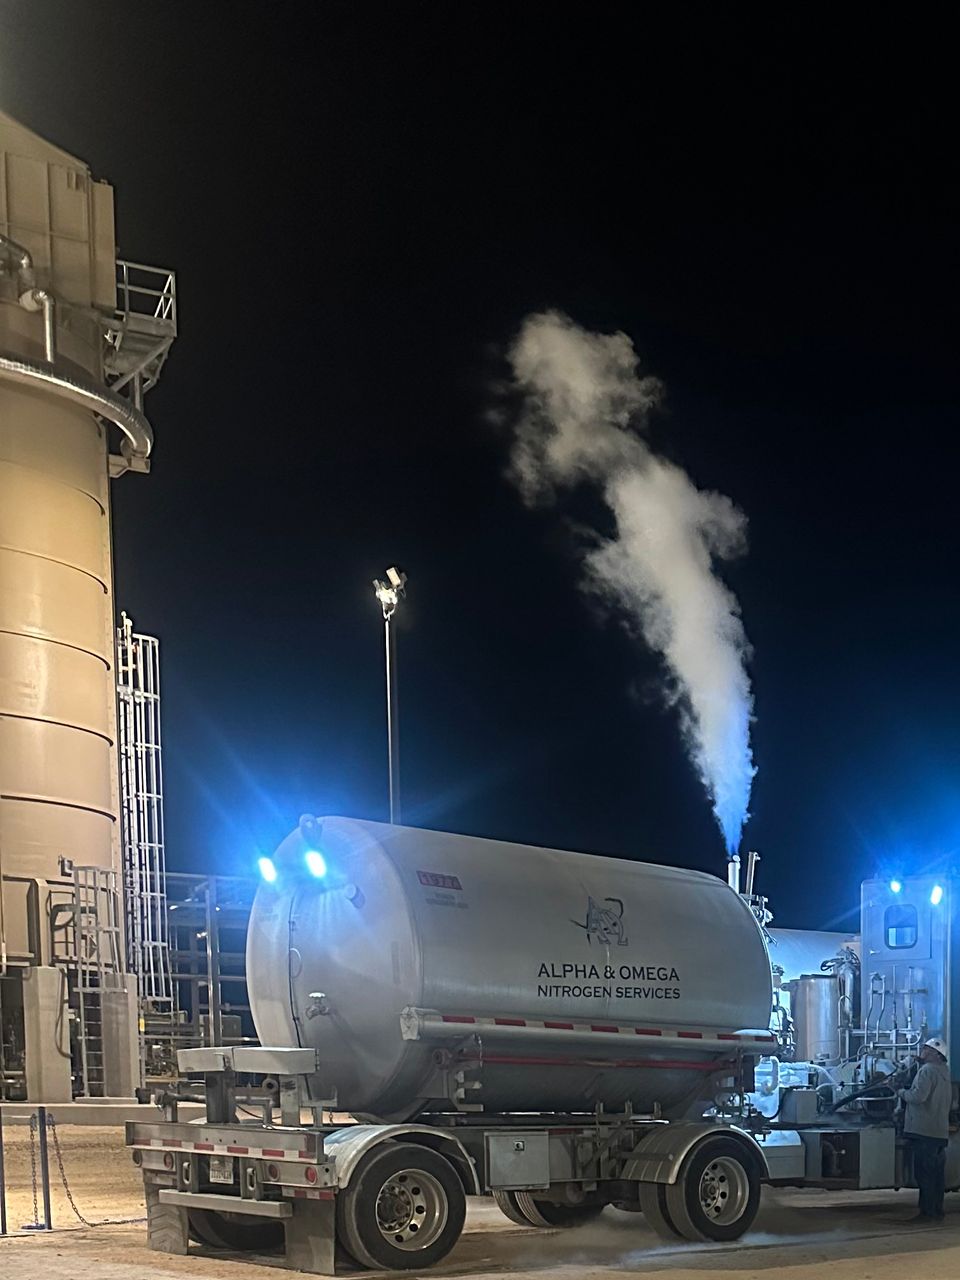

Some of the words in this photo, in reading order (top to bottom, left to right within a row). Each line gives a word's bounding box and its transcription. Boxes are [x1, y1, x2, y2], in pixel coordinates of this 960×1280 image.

[538, 963, 600, 979] ALPHA
[603, 965, 615, 979] &
[619, 966, 680, 982] OMEGA
[537, 985, 611, 998] NITROGEN
[616, 986, 681, 999] SERVICES
